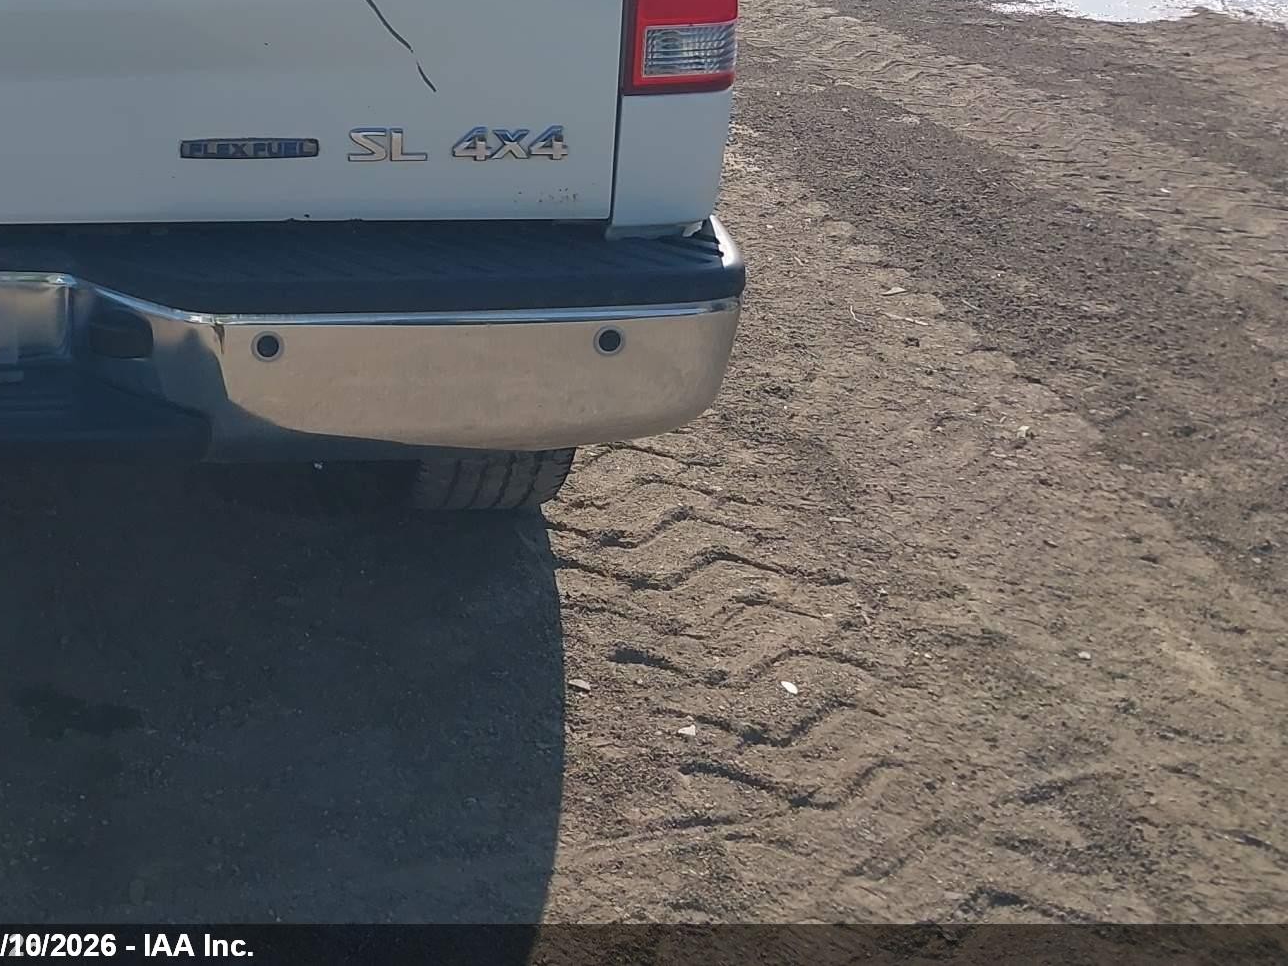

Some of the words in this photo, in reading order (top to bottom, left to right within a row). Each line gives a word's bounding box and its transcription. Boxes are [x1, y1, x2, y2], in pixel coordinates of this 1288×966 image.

[189, 141, 248, 156] FLEX
[252, 140, 318, 156] FUEL
[348, 127, 428, 162] SL
